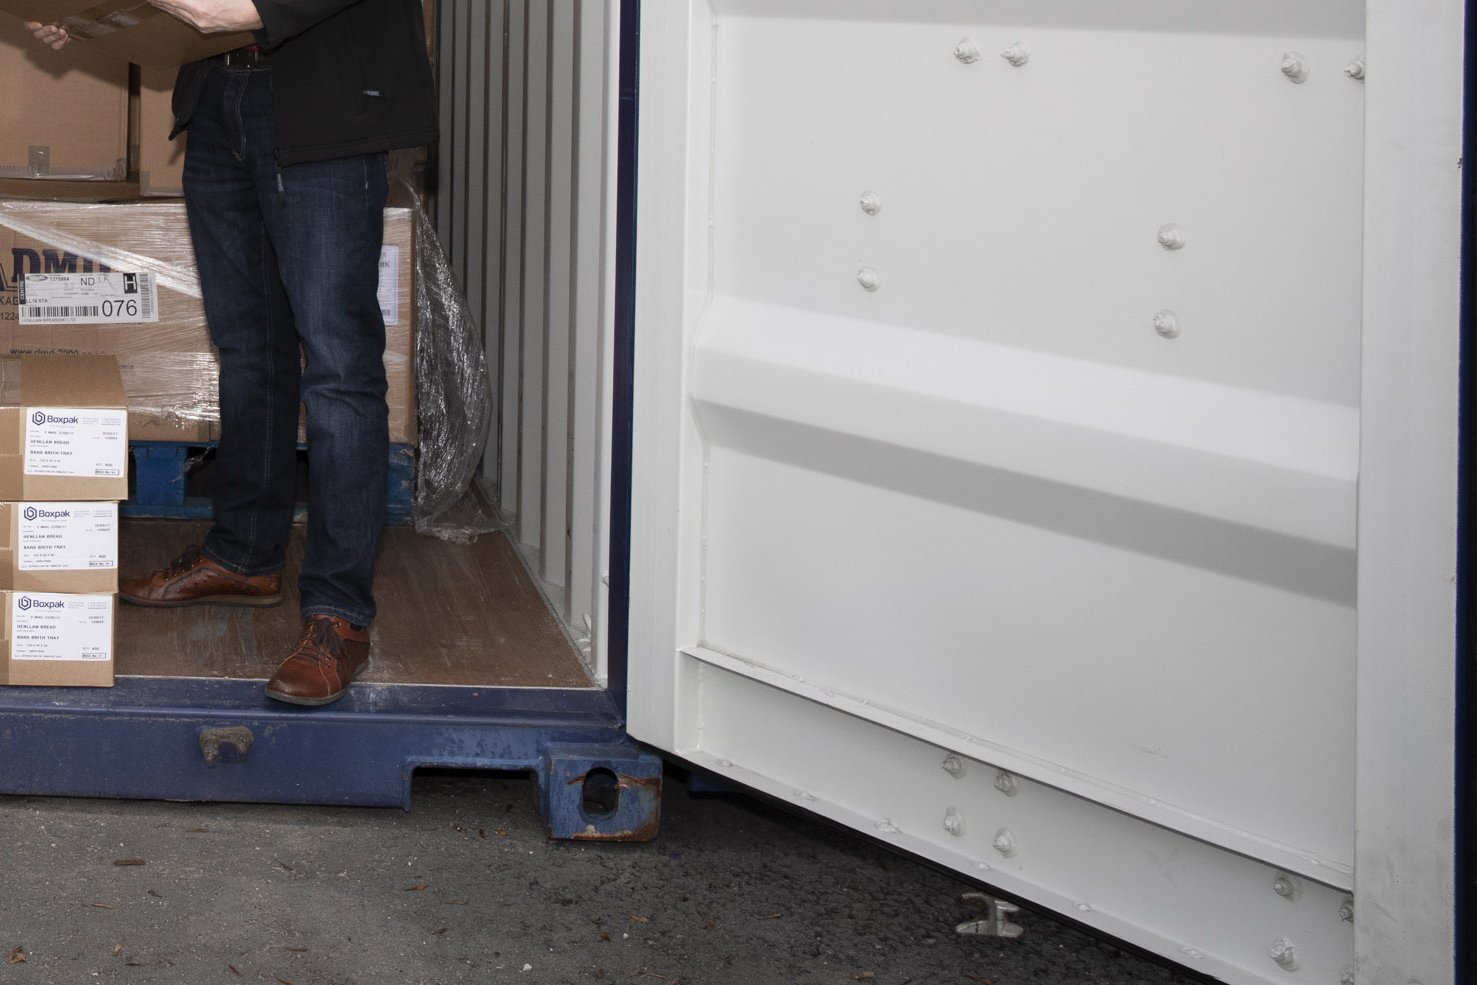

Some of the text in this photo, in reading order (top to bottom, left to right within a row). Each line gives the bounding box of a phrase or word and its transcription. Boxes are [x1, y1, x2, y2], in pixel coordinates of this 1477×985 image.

[80, 277, 96, 286] ND
[125, 276, 136, 290] H
[102, 299, 138, 317] 076
[46, 415, 78, 424] Boxpak
[38, 510, 70, 518] Boxpak
[33, 600, 64, 609] Boxpak
